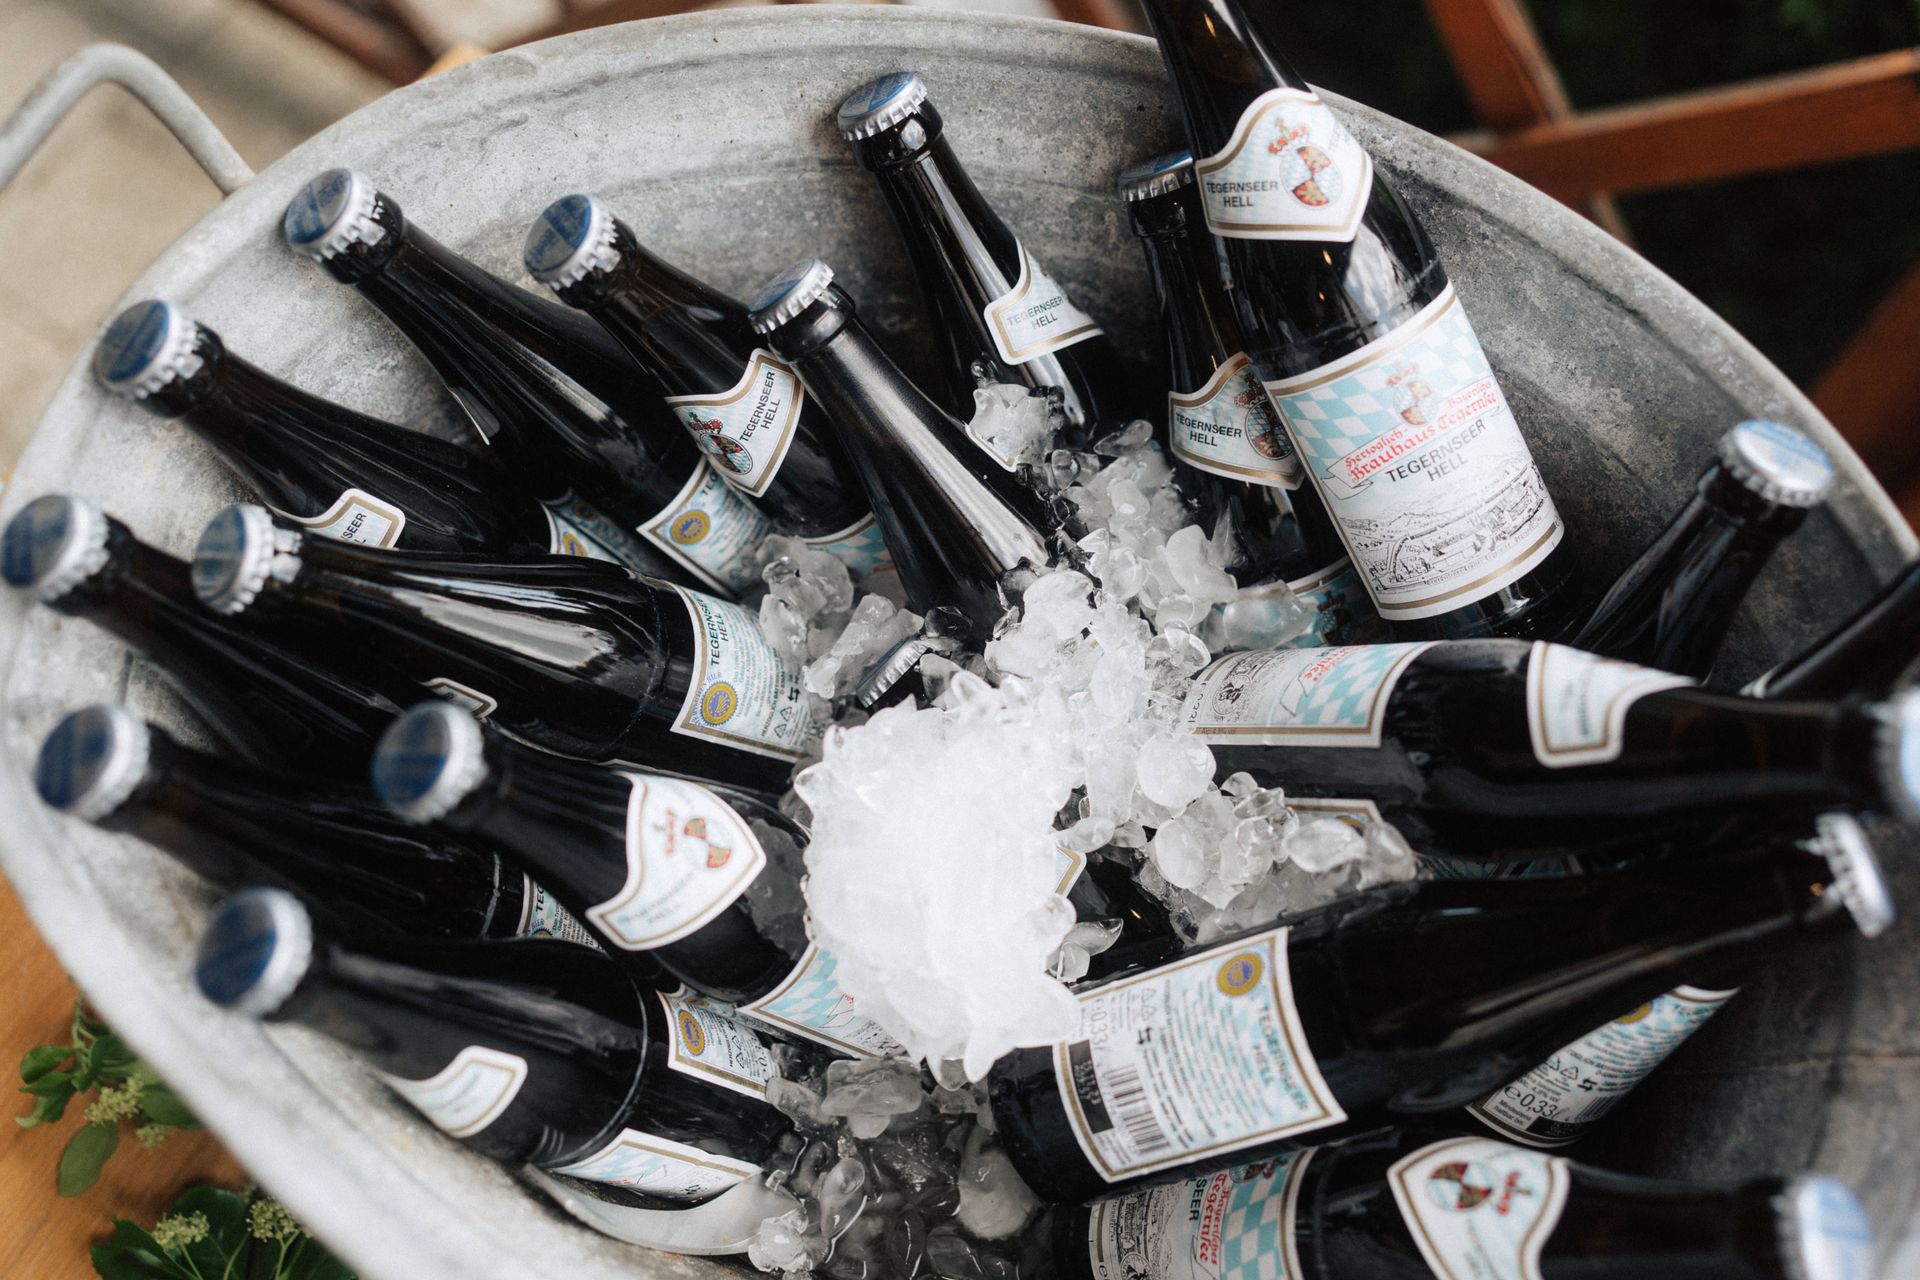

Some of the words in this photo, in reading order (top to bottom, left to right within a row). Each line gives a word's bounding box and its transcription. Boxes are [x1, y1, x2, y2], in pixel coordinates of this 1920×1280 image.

[1206, 180, 1279, 194] TEGERNSEER
[1223, 195, 1254, 208] HELL
[1007, 296, 1063, 327] TEGERNSEER
[1031, 313, 1058, 330] HELL
[739, 371, 776, 442] TEGERNSEER
[760, 399, 781, 430] HELL
[1176, 413, 1242, 438] TEGERNSEER
[1190, 430, 1218, 447] HELL
[1347, 426, 1438, 483] Brauhaus
[1385, 418, 1488, 484] TEGERNSEER
[1426, 453, 1469, 482] HELL
[717, 612, 729, 642] HELL
